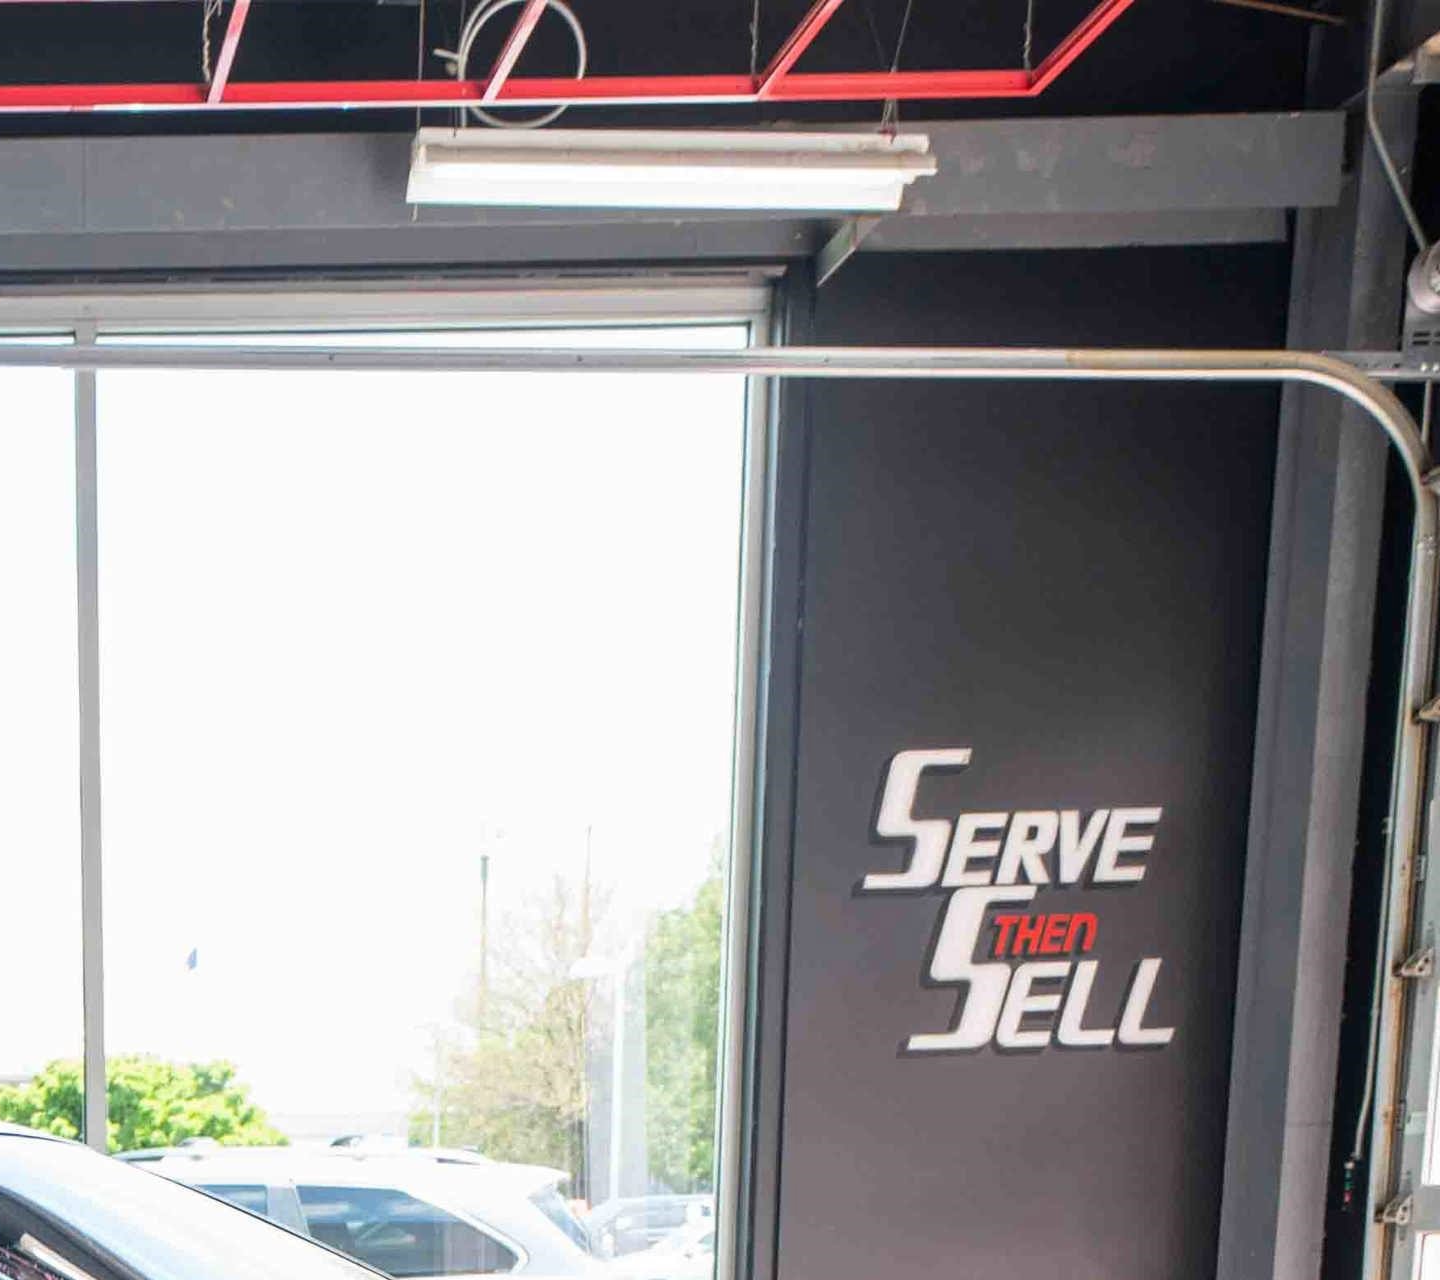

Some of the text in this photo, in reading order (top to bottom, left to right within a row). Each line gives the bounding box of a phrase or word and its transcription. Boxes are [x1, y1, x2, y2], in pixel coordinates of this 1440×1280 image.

[862, 748, 1163, 889] SERVE
[906, 885, 1175, 1051] SELL
[992, 912, 1098, 956] THEN
